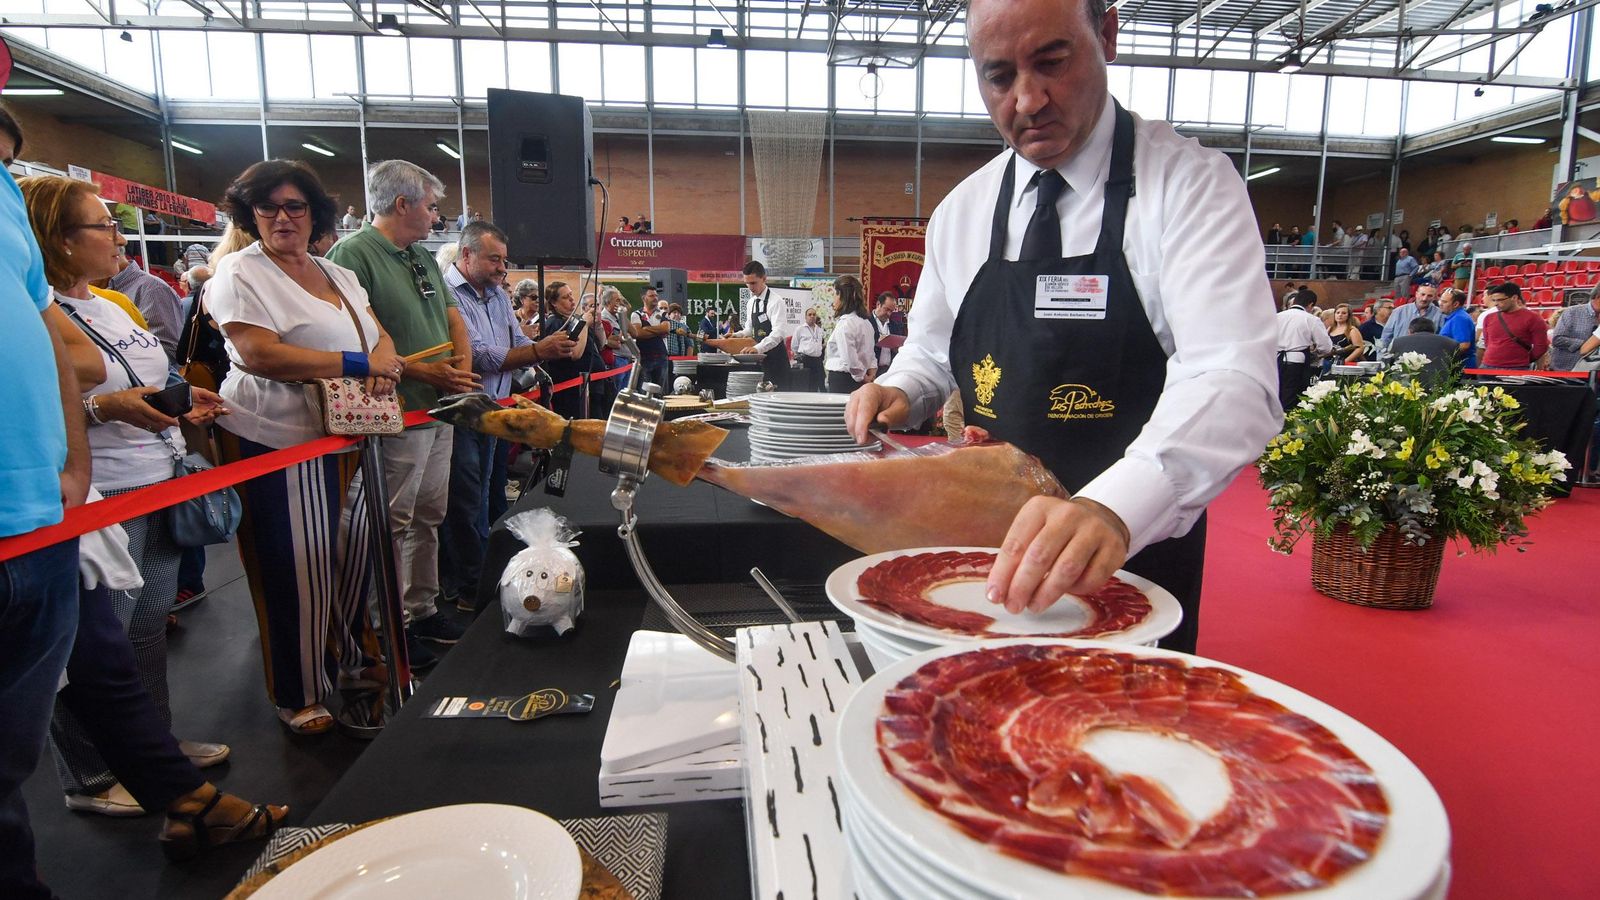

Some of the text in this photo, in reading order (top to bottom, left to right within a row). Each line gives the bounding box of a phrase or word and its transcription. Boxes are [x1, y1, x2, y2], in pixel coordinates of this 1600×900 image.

[127, 184, 153, 201] LATIBER
[155, 192, 171, 204] 2010
[160, 201, 168, 211] LA
[610, 236, 663, 249] Cruzcampo
[617, 249, 657, 258] ESPECIAL
[784, 297, 794, 308] RIA
[1050, 399, 1068, 412] Los
